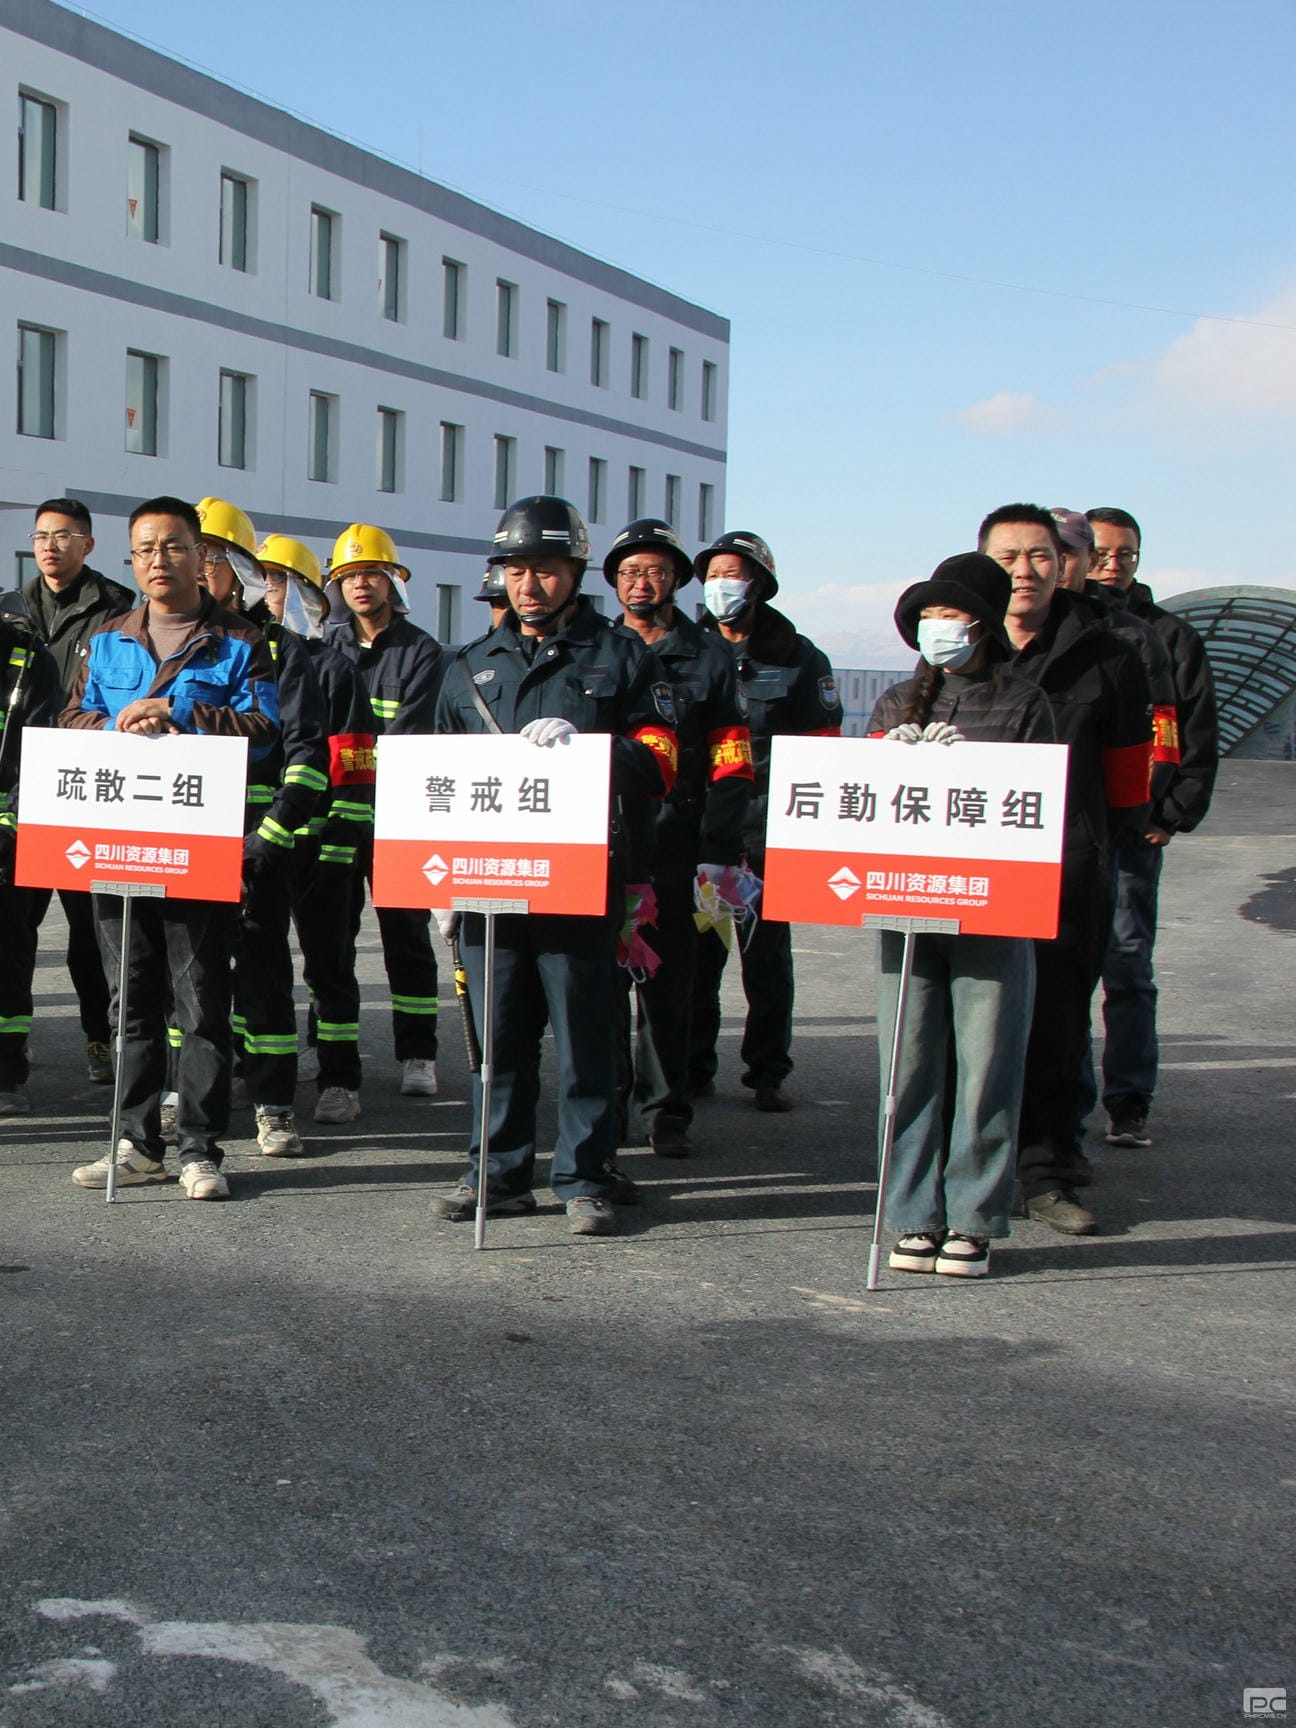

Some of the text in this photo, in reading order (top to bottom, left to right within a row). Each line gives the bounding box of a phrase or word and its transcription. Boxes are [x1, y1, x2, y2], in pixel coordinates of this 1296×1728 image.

[56, 767, 205, 808] 疏散二组
[425, 775, 552, 814] 警戒组
[785, 781, 1045, 830] 后勤保障组
[94, 843, 190, 867] 四川资源集团
[94, 862, 189, 875] SICHUAN RESOURCES GROUP
[452, 857, 551, 878] 四川资源集团
[451, 878, 550, 888] SICHUAN RESOURCES GROUP
[865, 871, 990, 897] 四川资源集团
[866, 892, 989, 907] SICHUAN RESOURCES GROUP
